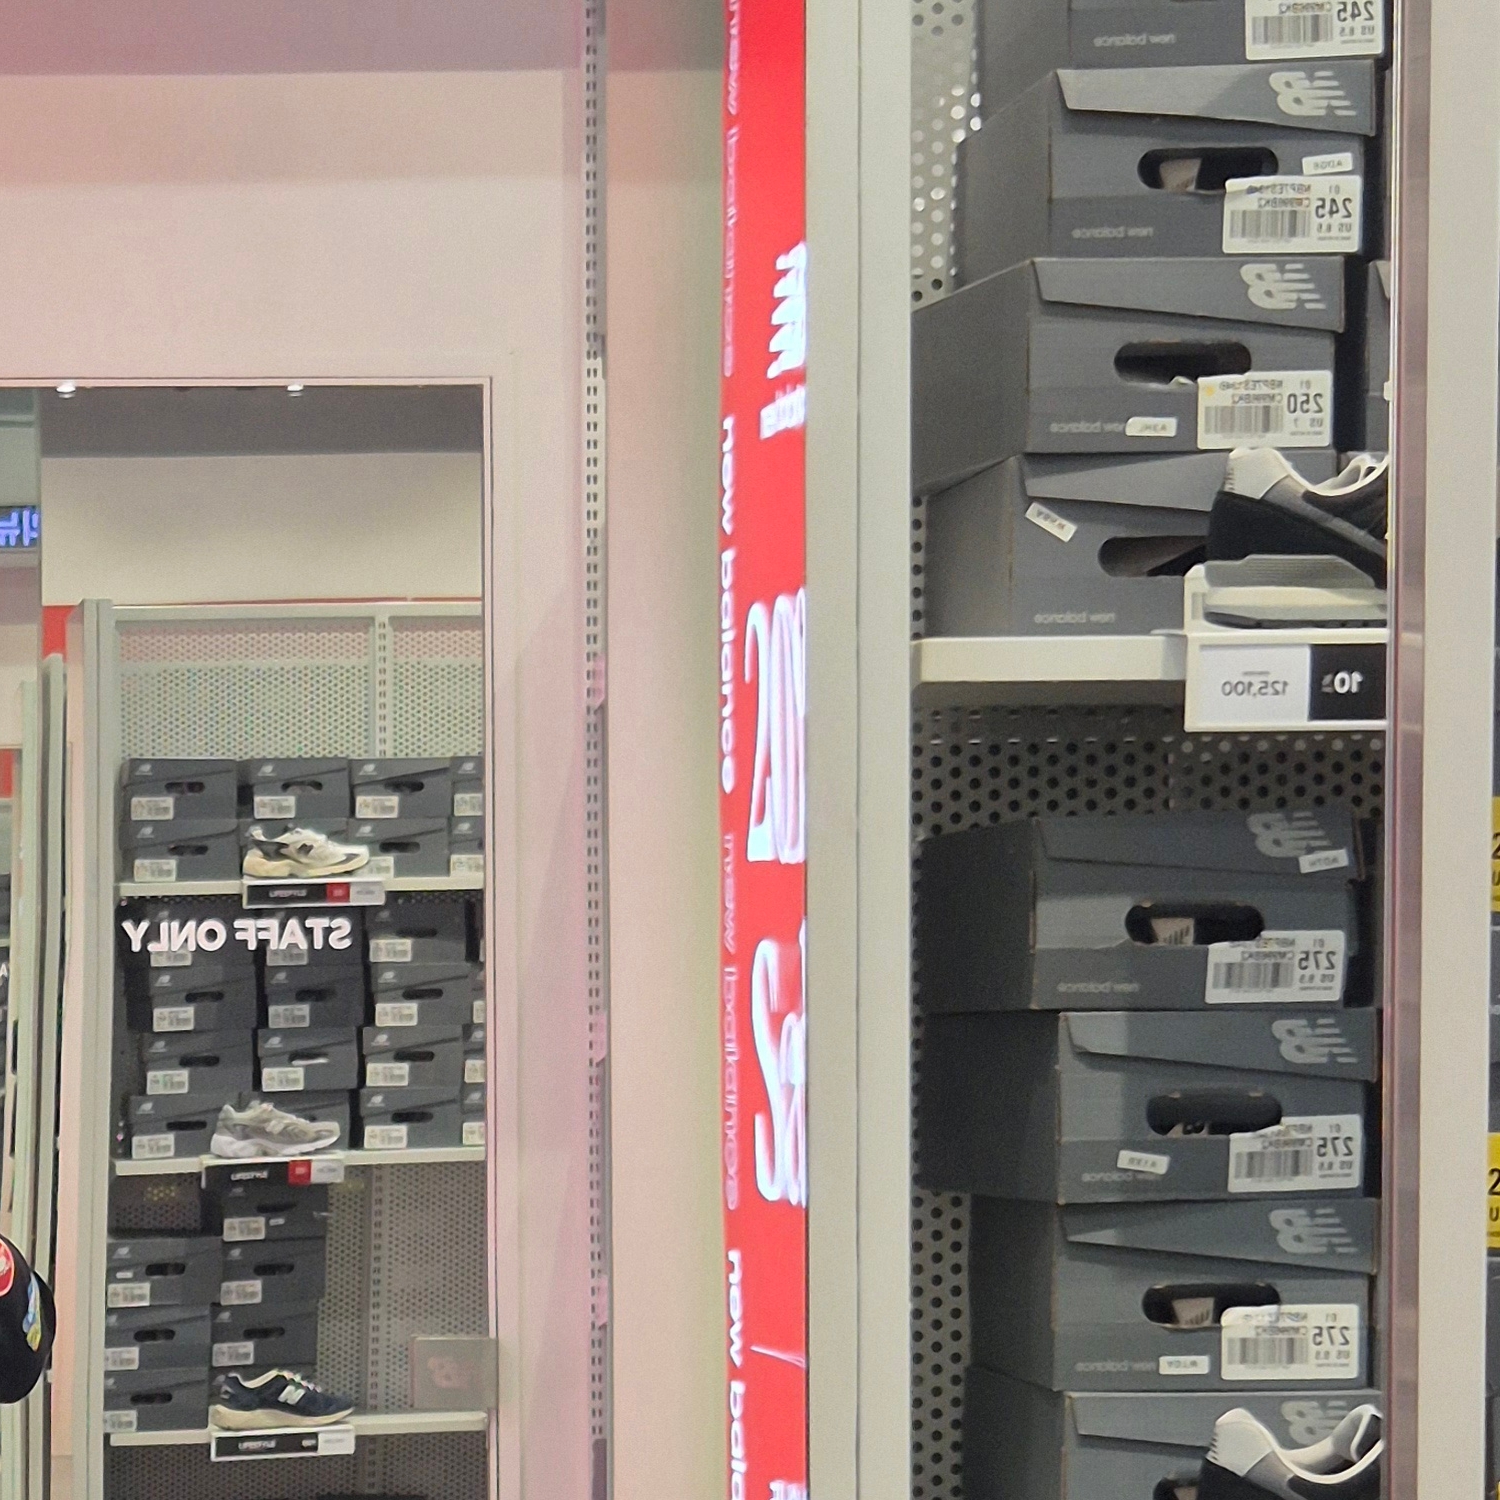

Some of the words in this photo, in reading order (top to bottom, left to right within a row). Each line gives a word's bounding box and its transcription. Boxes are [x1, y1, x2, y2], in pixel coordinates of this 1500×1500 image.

[720, 414, 736, 535] new
[719, 547, 736, 795] balance
[728, 1249, 744, 1367] new
